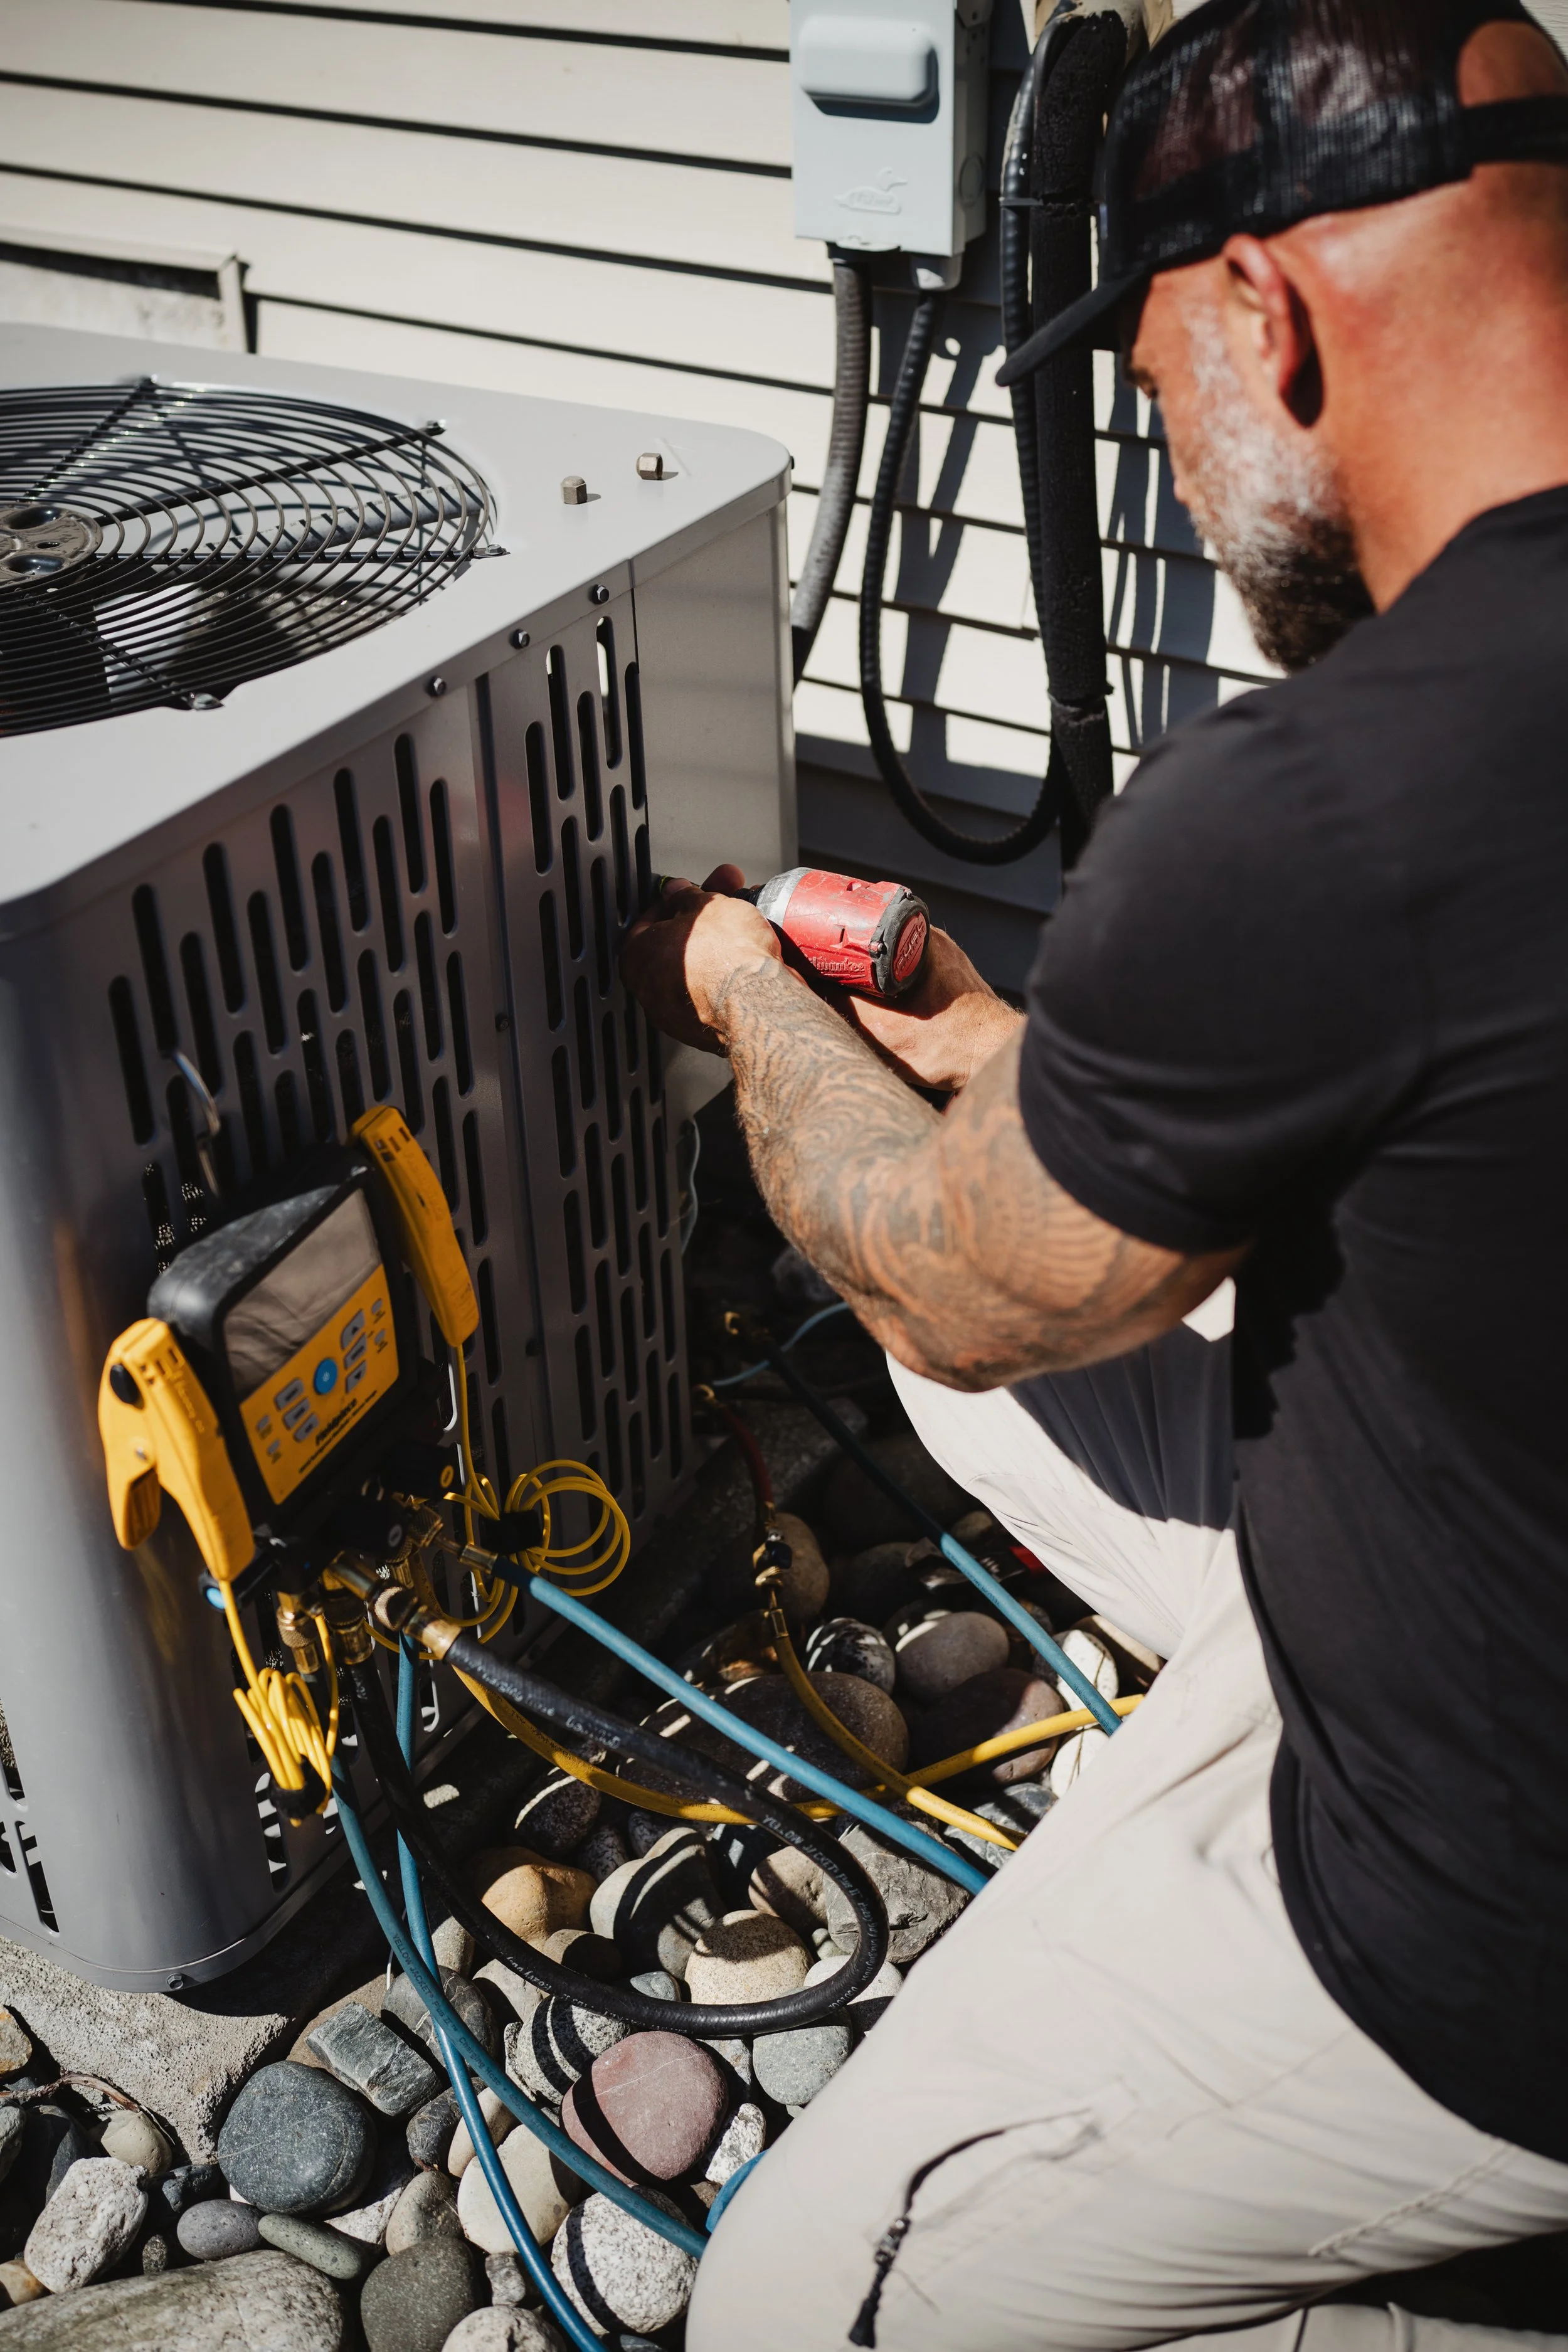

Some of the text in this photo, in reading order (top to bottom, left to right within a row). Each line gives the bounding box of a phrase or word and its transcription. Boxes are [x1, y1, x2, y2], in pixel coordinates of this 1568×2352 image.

[896, 921, 924, 973] FUEL
[763, 1814, 805, 1845] YELLOW
[393, 1934, 413, 1967] YELLOW
[433, 1998, 448, 2021] Plus
[458, 2037, 485, 2070] Charging
